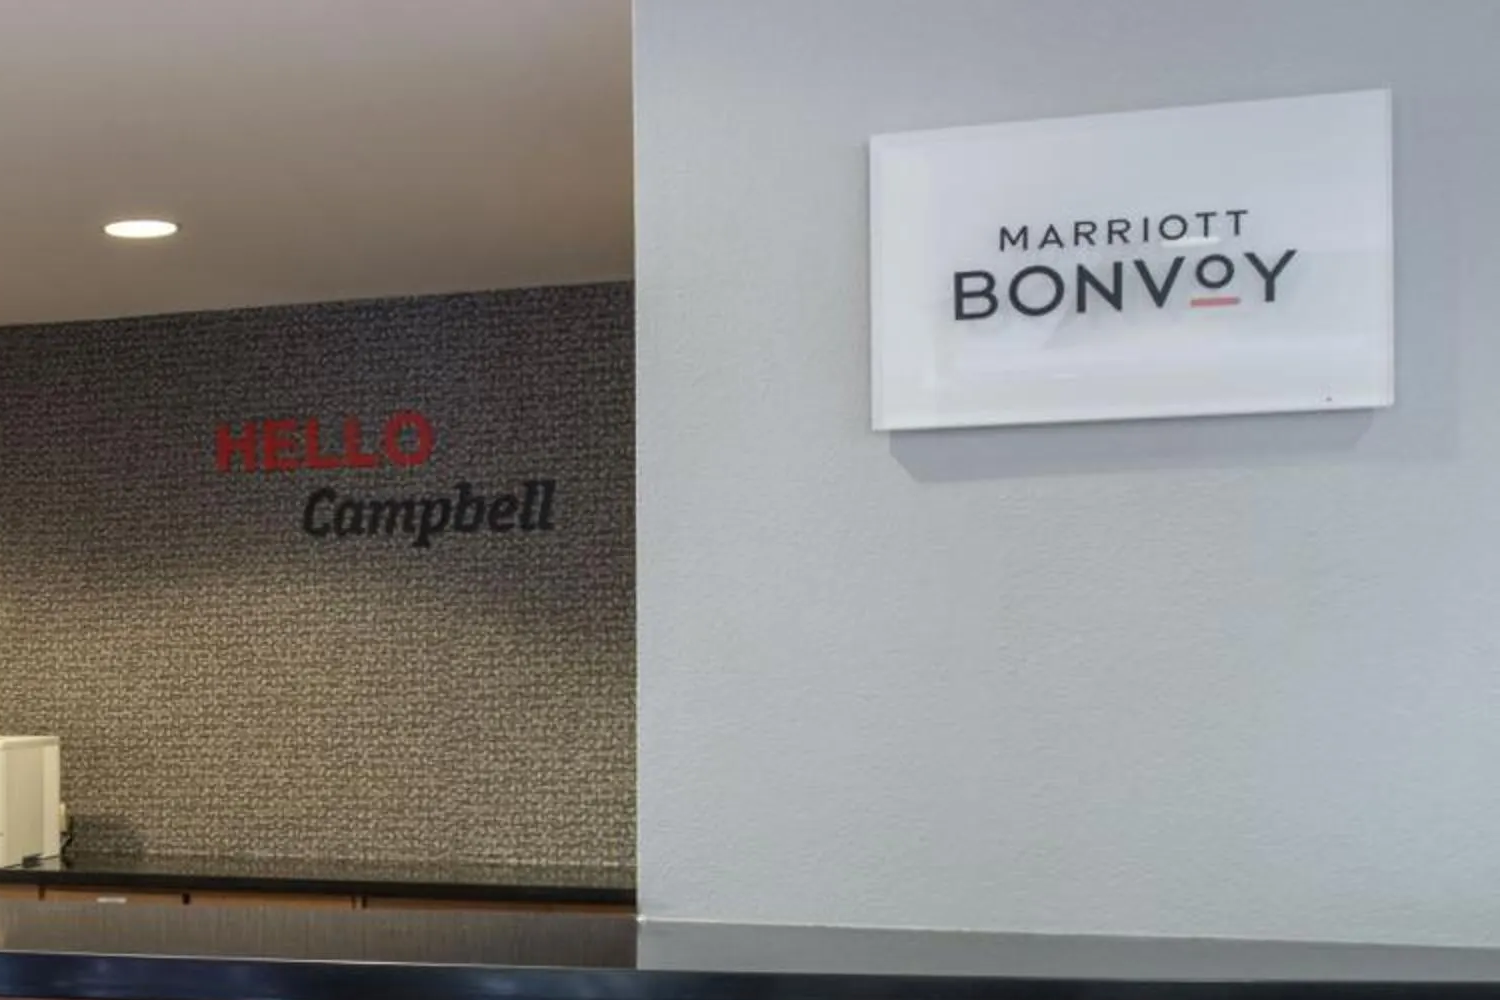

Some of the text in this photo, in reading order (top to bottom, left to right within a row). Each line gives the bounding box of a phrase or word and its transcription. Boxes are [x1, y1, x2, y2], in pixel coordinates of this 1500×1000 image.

[999, 209, 1249, 252] MARRIOTT
[953, 248, 1298, 321] BONVOY
[214, 409, 437, 474] HELLO
[303, 479, 557, 549] Campbell
